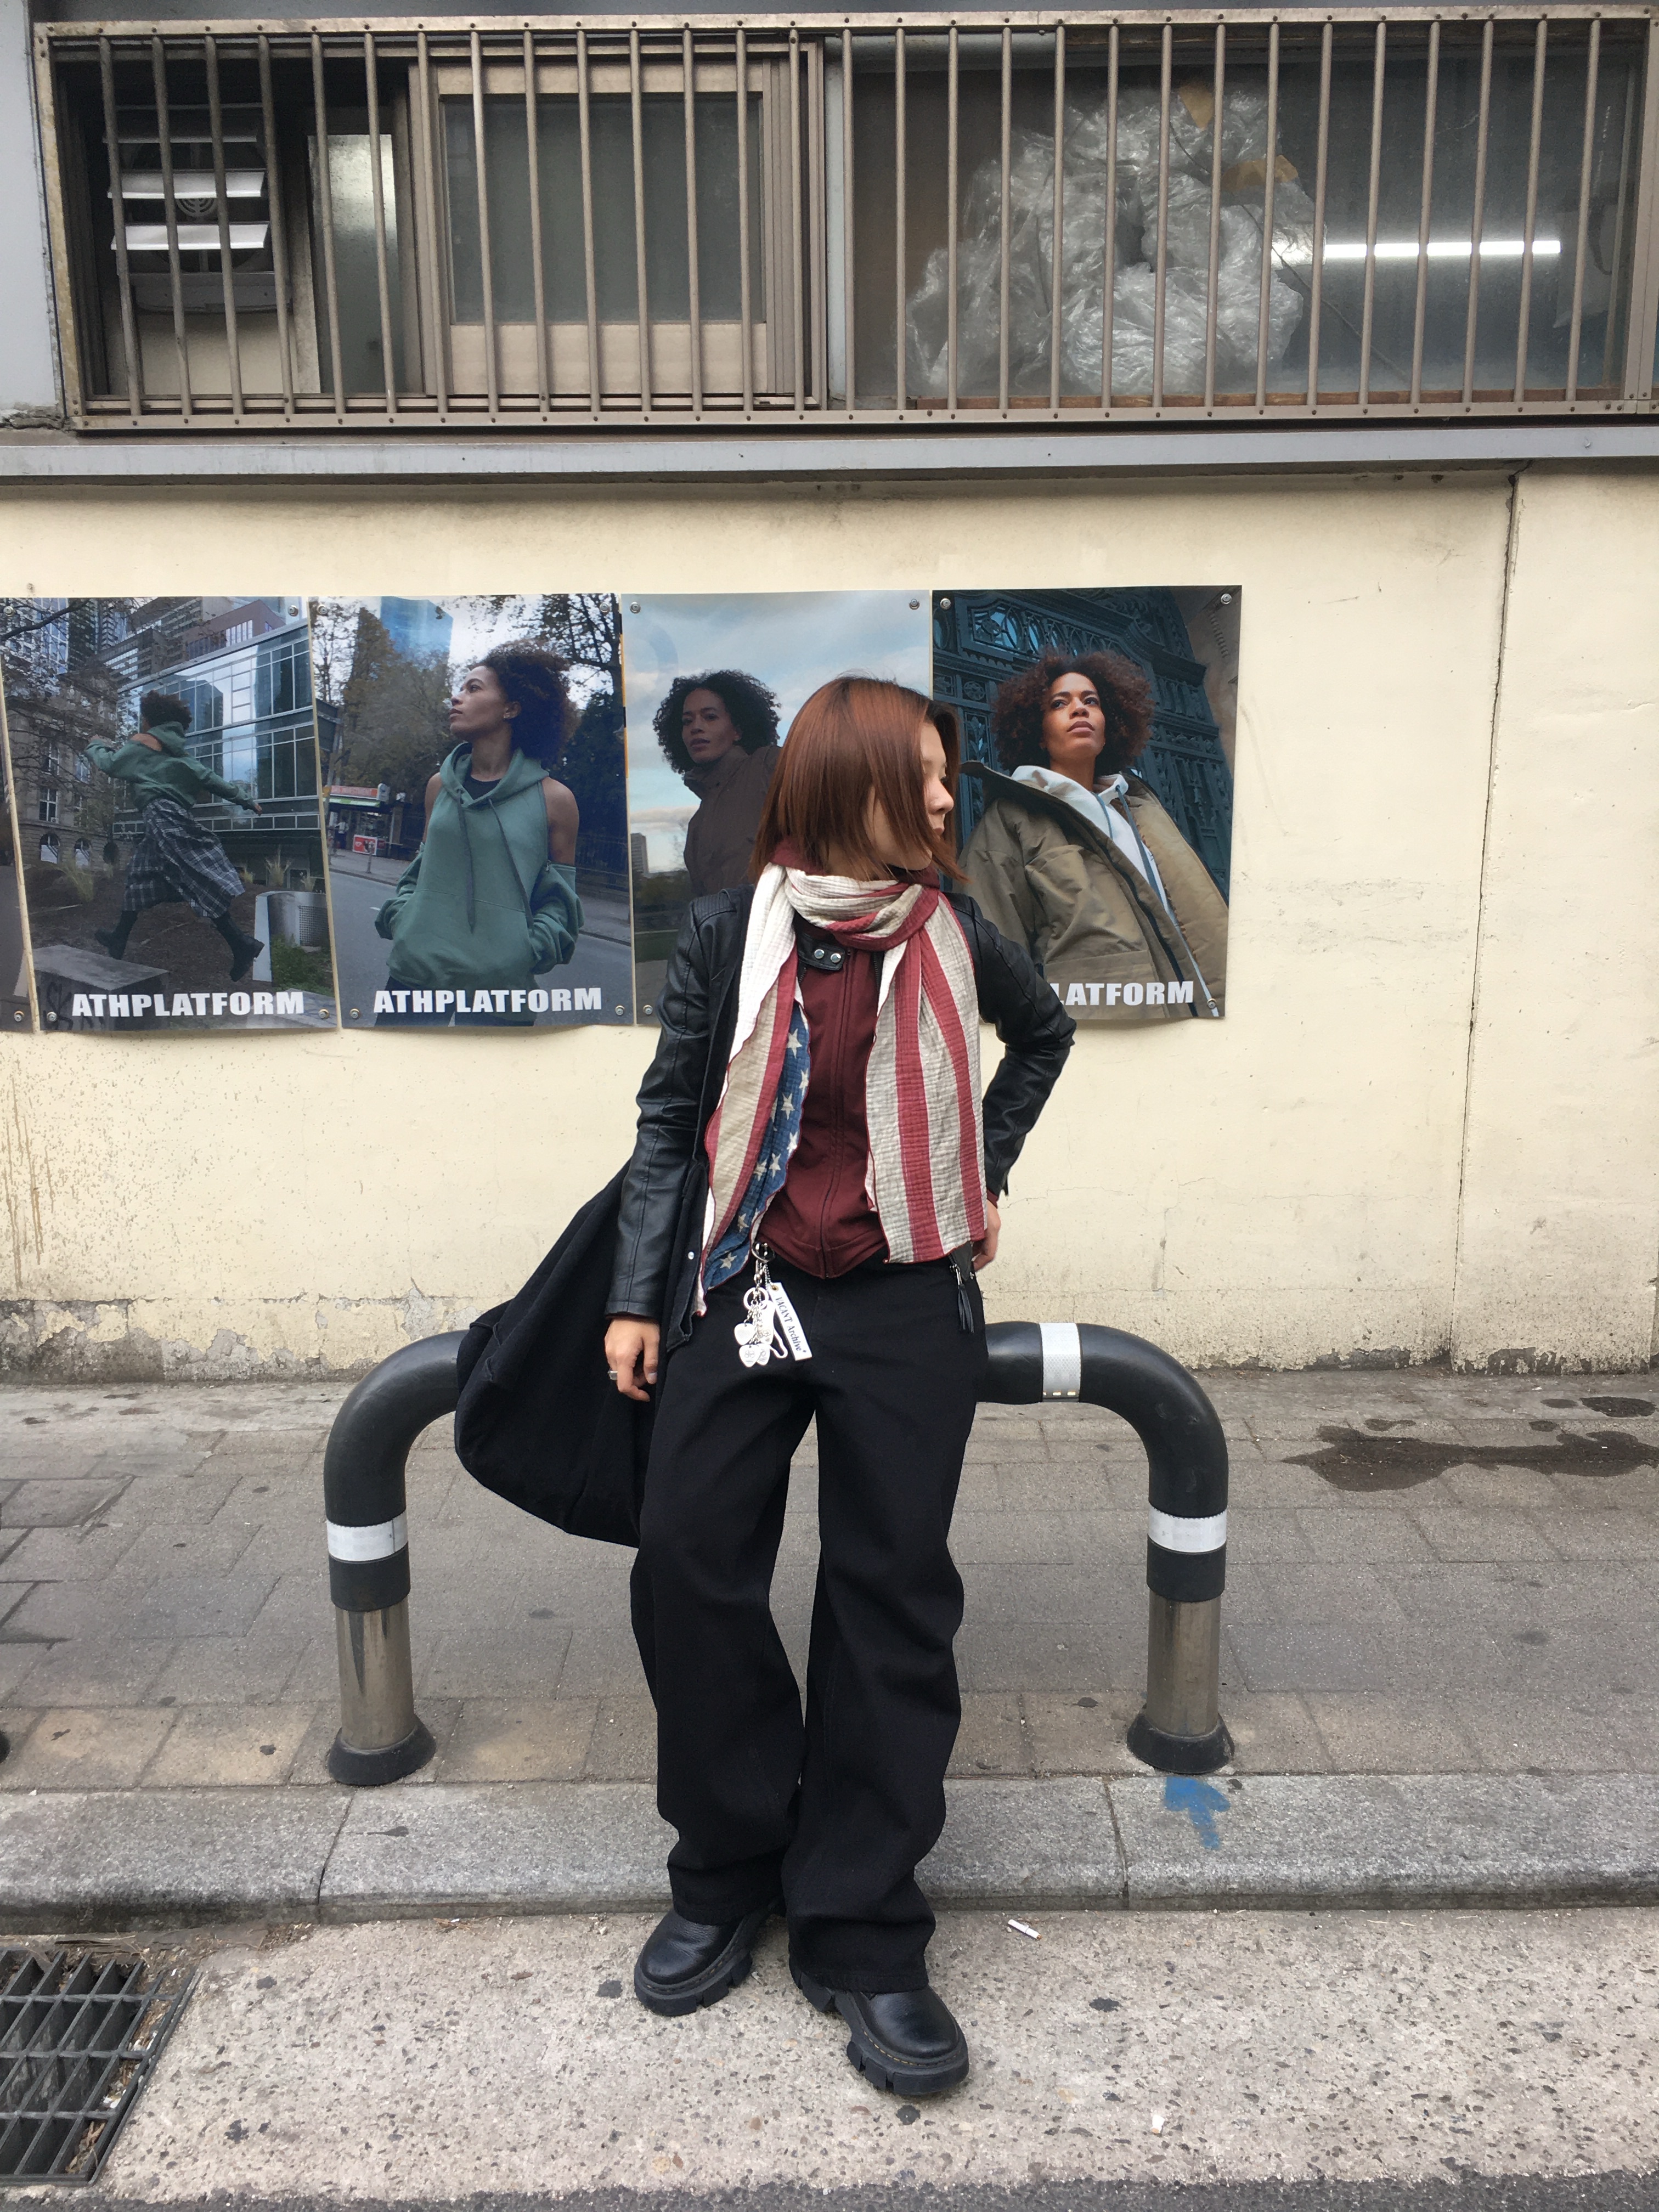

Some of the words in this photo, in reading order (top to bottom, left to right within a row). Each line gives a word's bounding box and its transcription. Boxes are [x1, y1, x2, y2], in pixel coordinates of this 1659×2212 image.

[72, 991, 304, 1017] ATHPLATFORM
[374, 988, 602, 1013] ATHPLATFORM
[776, 1297, 793, 1322] VACANT
[787, 1326, 802, 1351] Archive
